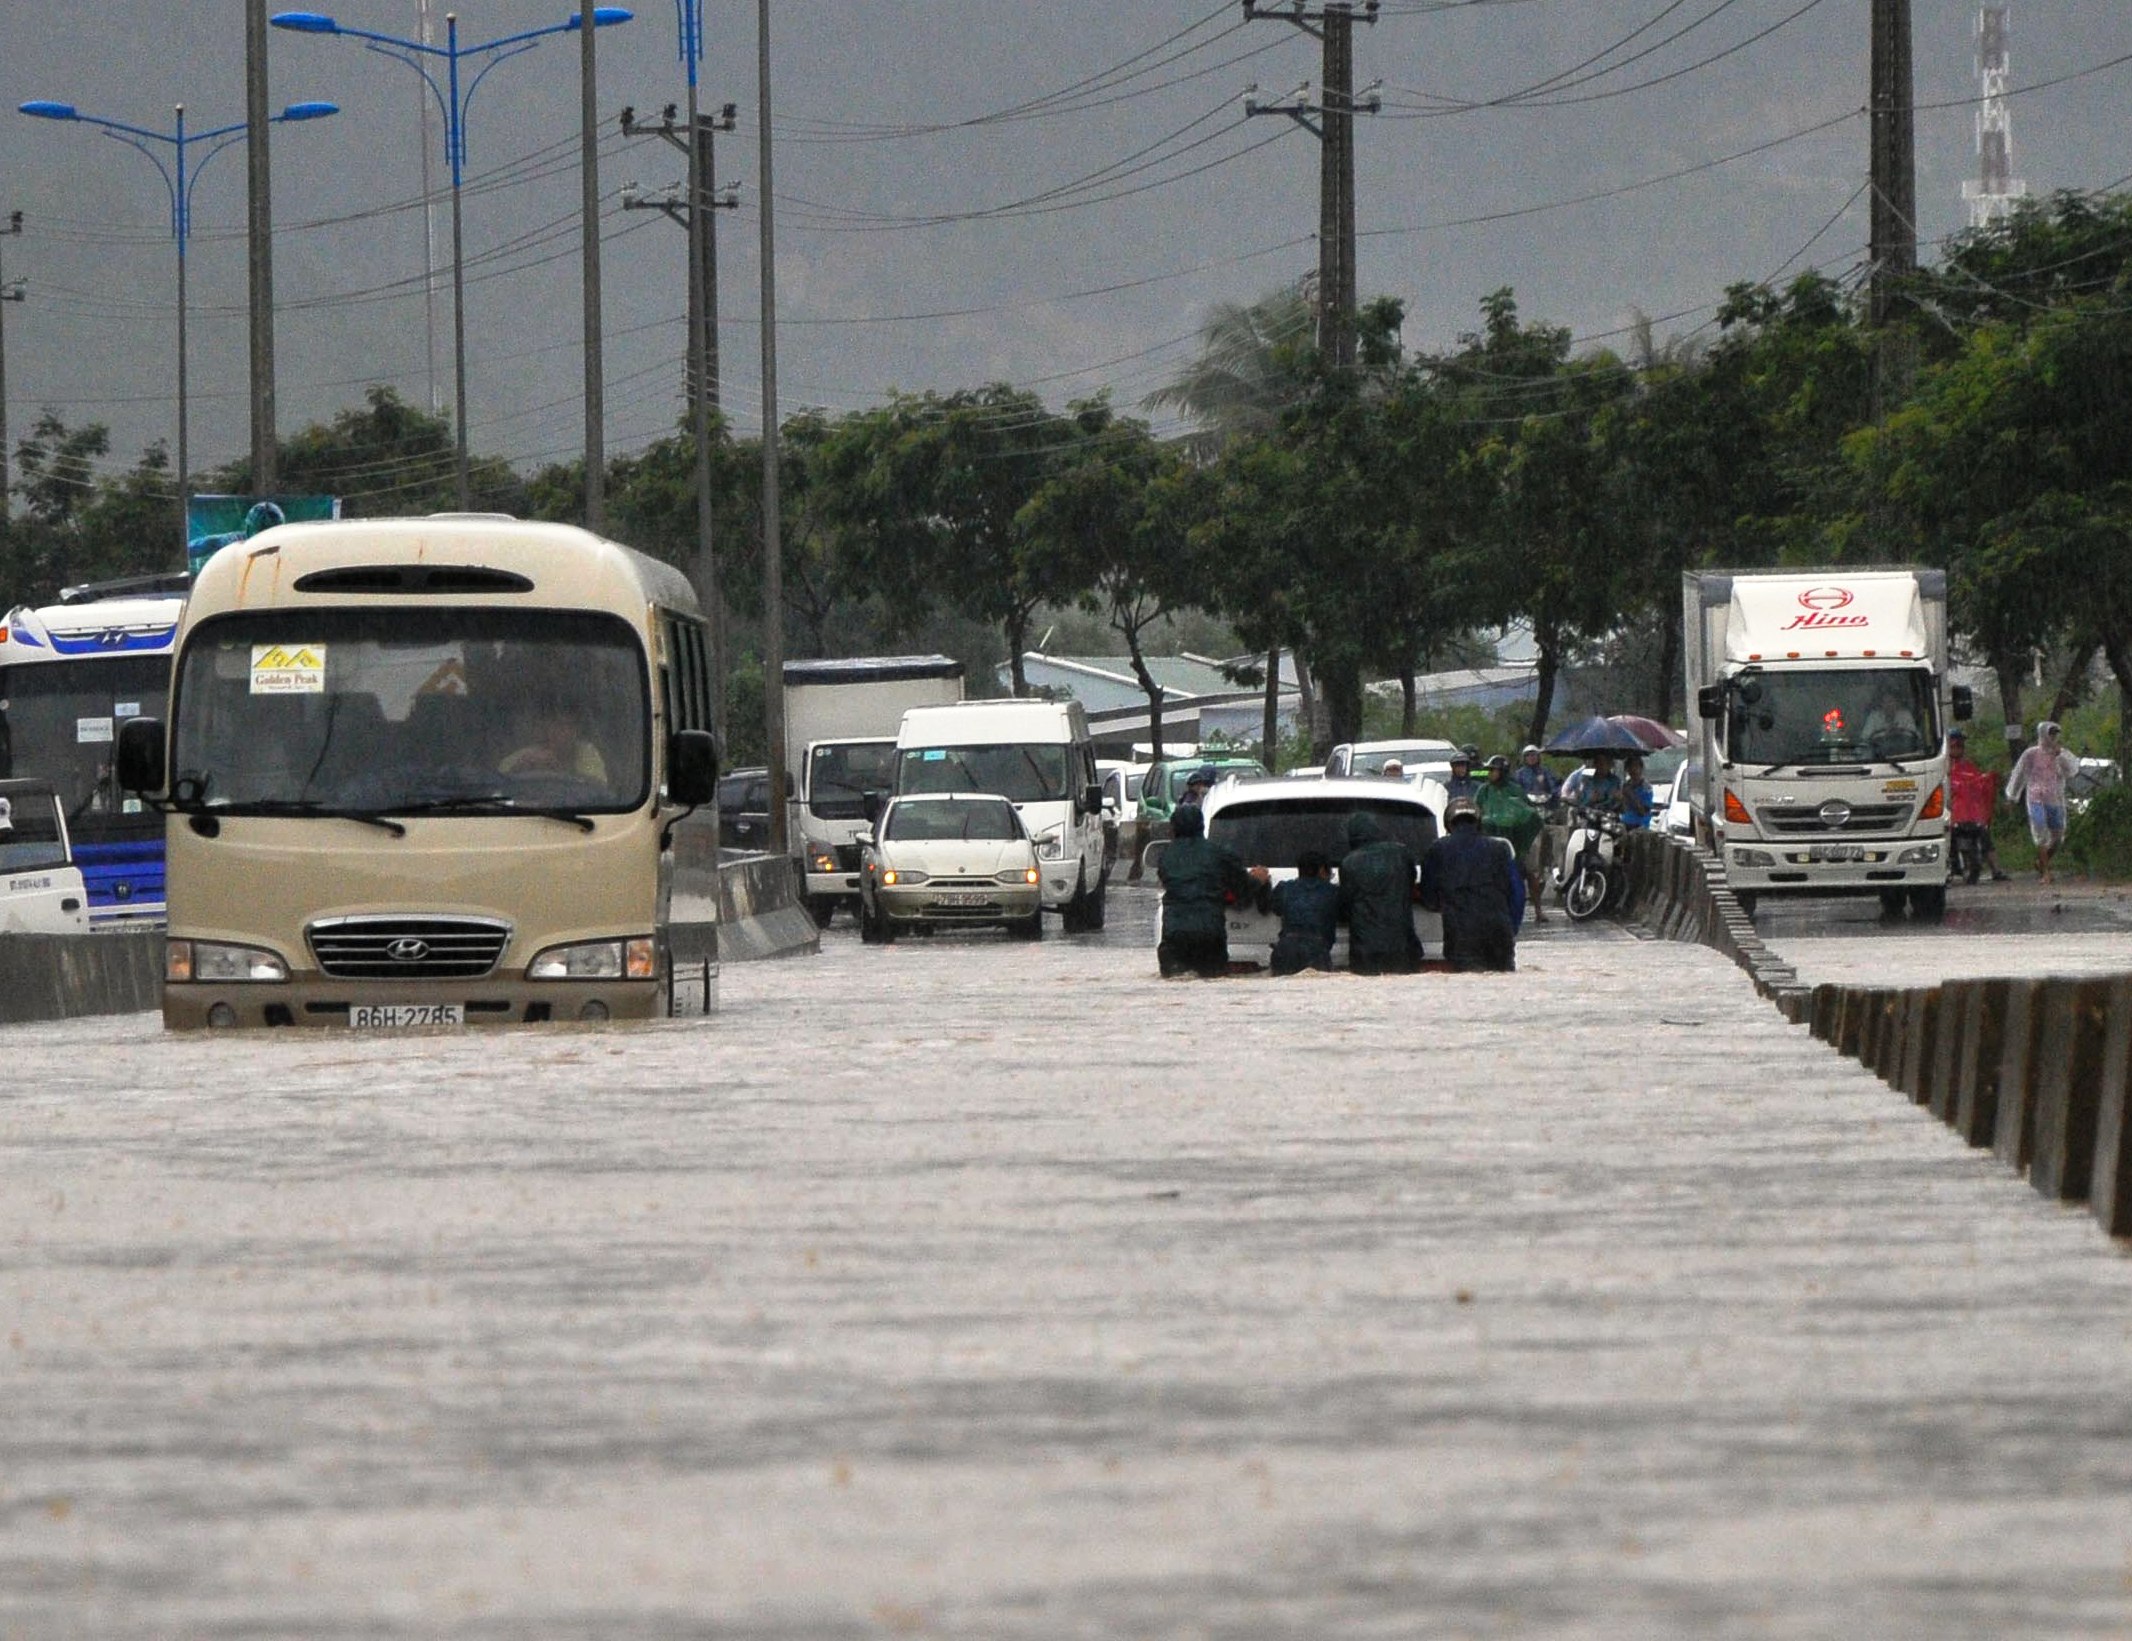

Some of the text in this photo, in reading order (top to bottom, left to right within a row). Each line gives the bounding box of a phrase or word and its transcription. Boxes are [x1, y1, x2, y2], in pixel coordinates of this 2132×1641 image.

[1780, 611, 1868, 630] Hino
[255, 673, 319, 686] Golden Peak
